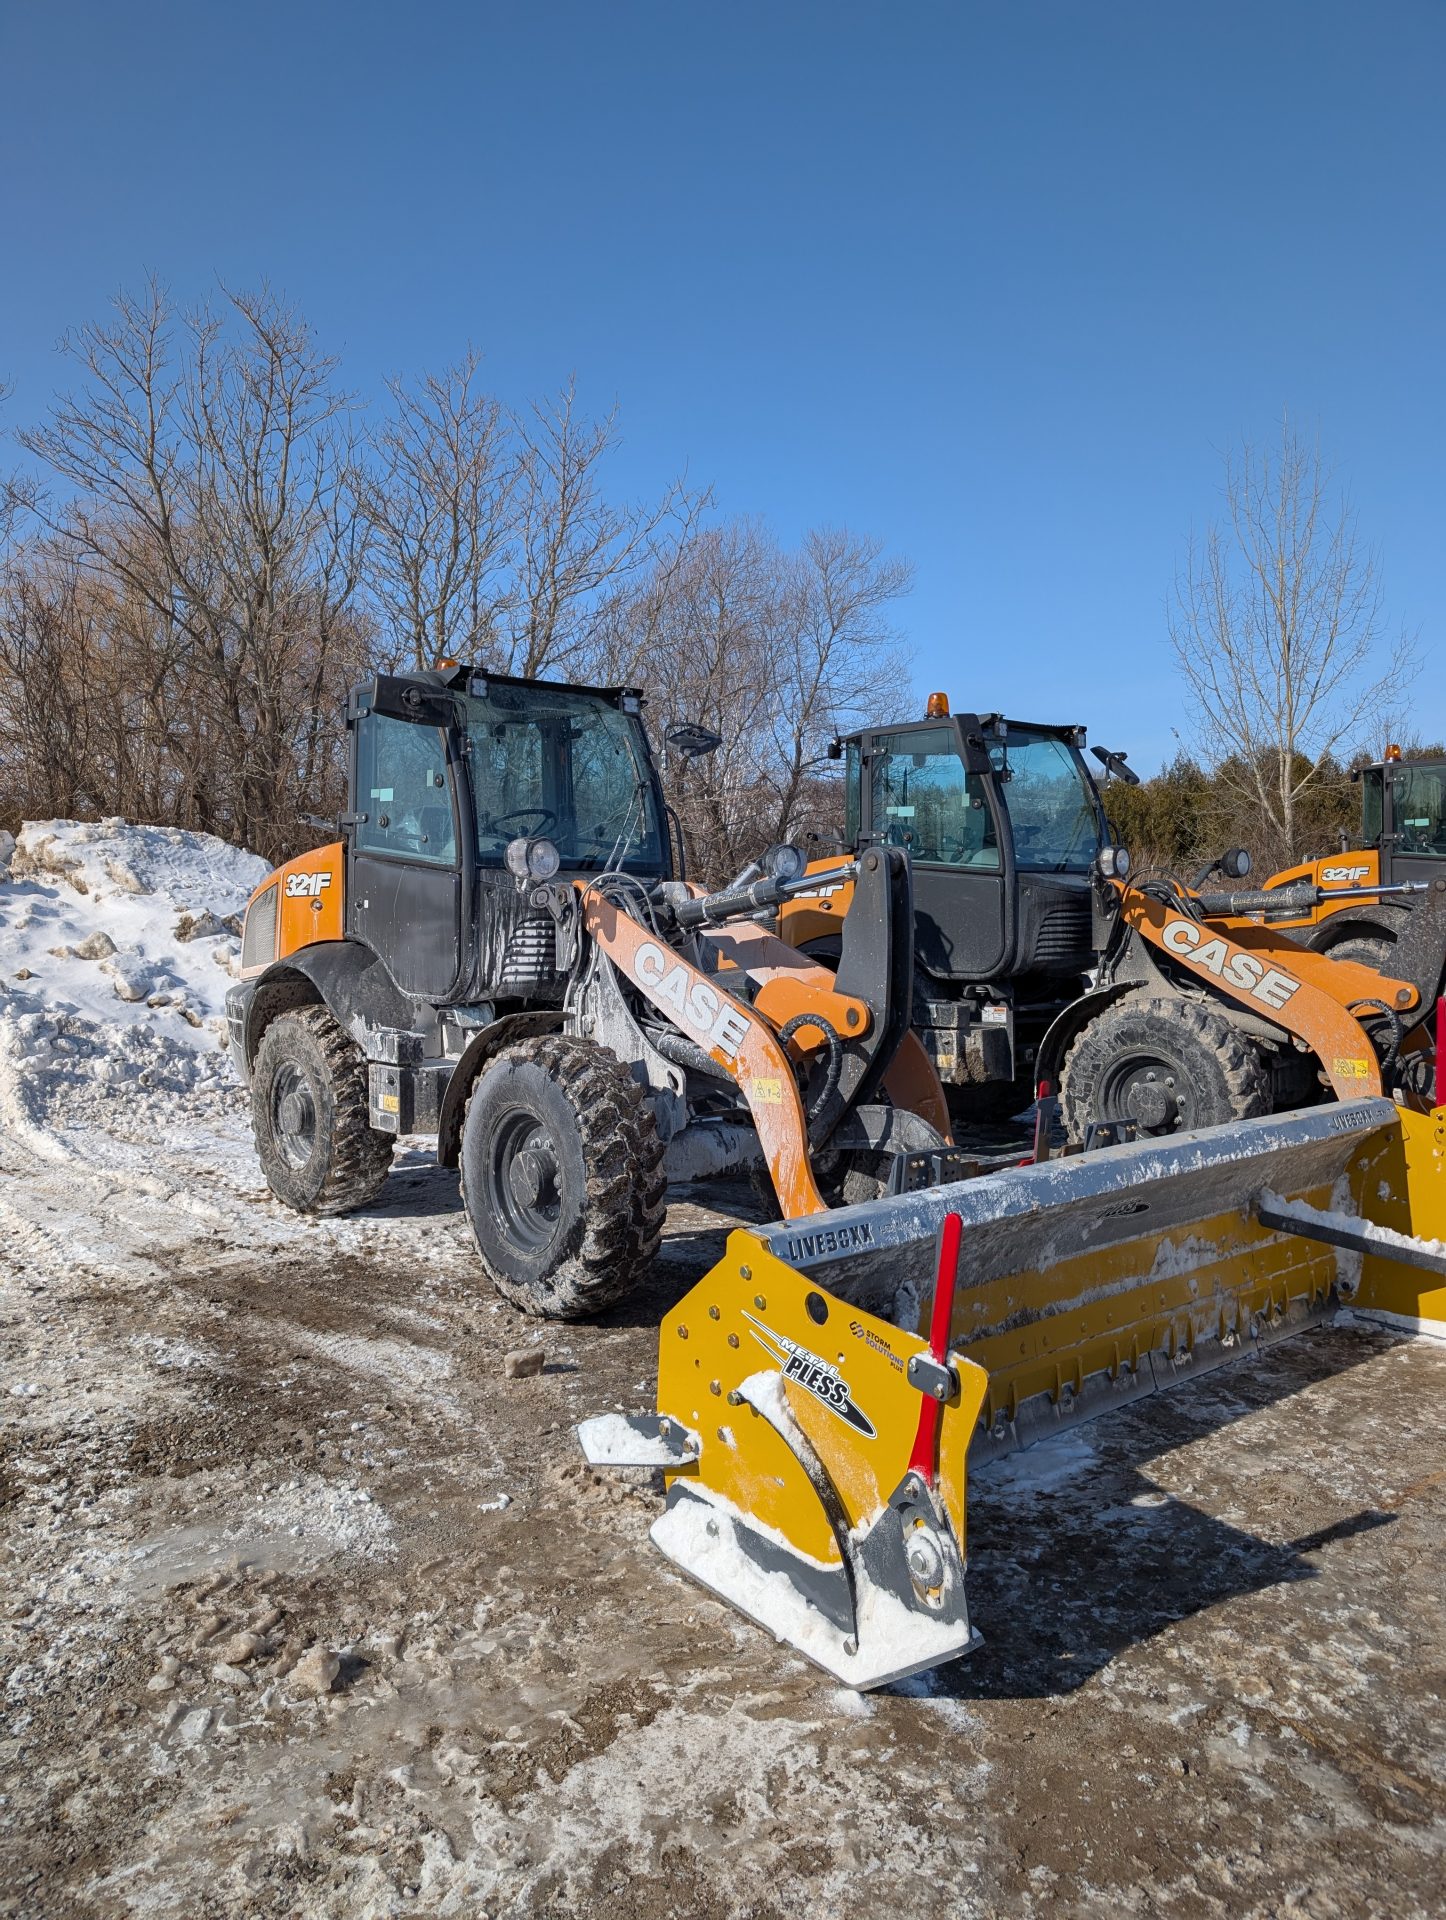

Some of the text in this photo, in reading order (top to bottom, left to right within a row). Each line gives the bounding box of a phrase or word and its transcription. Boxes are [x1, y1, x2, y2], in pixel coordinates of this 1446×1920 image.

[285, 872, 332, 897] 321F
[1321, 866, 1370, 881] 321F
[1162, 920, 1302, 1011] CASE
[634, 941, 752, 1059] CASE
[788, 1222, 875, 1261] LIVEBOXX
[865, 1336, 904, 1368] SOLUTIONS
[866, 1329, 891, 1351] STORM
[780, 1337, 840, 1379] METAL
[890, 1361, 903, 1374] PLUS
[784, 1354, 849, 1406] PLESS
